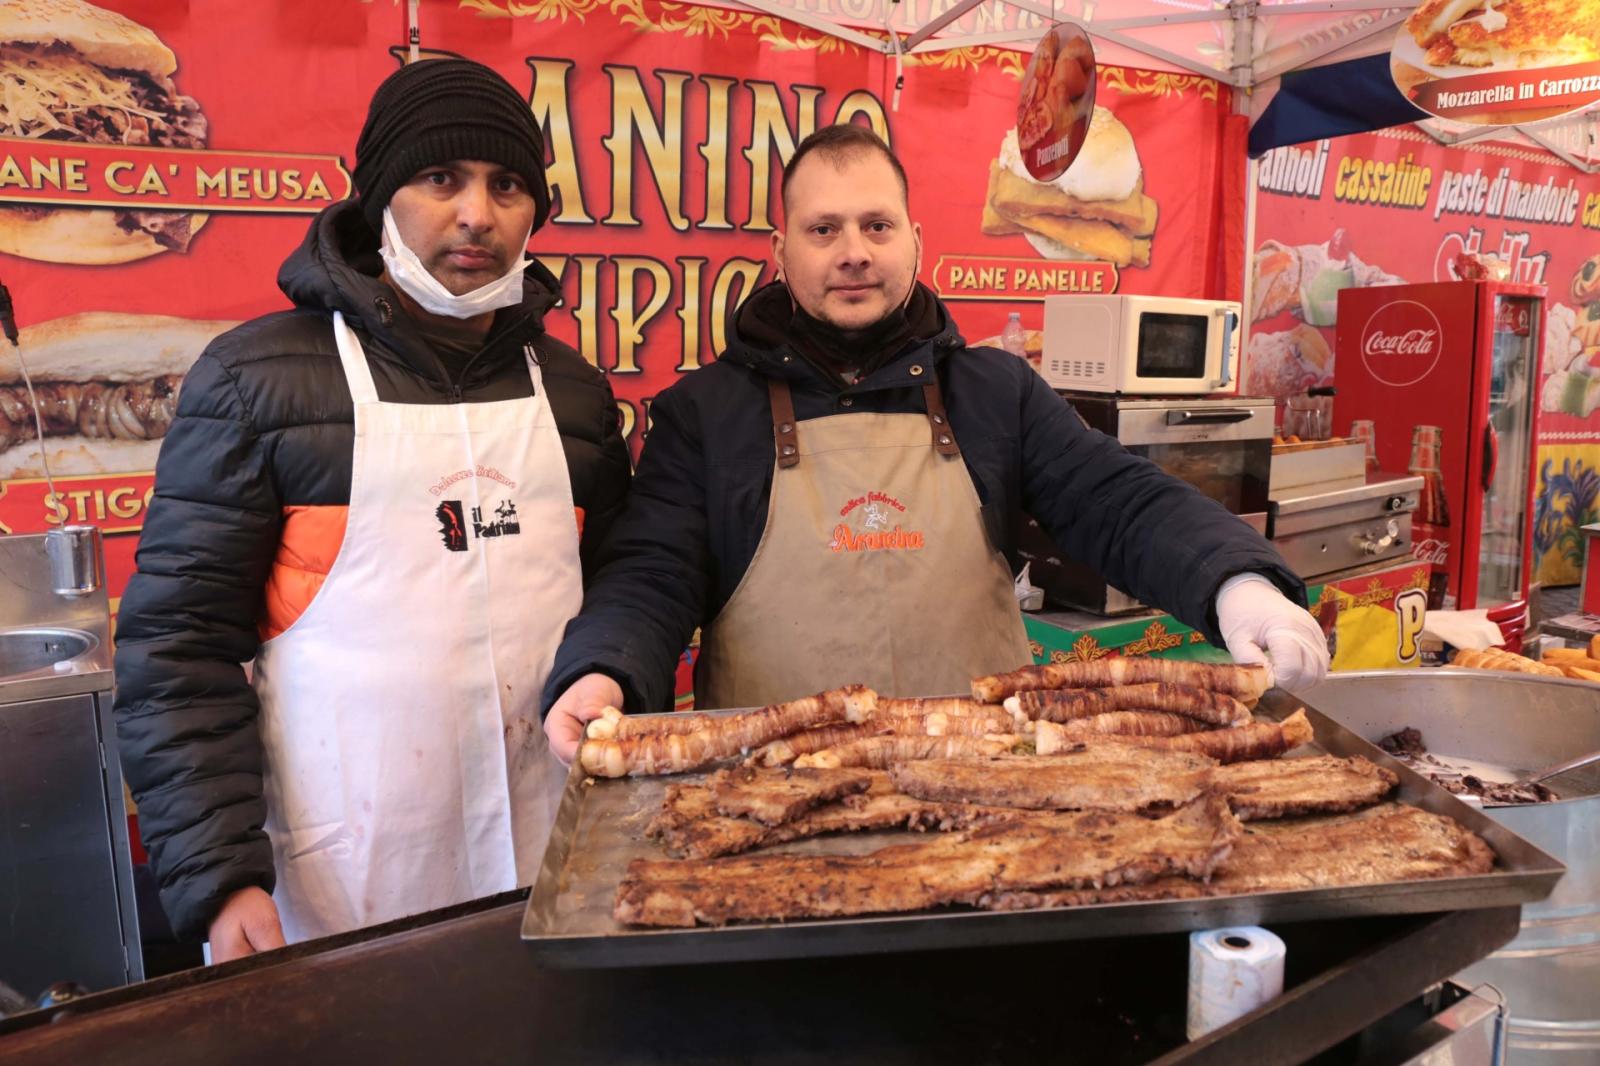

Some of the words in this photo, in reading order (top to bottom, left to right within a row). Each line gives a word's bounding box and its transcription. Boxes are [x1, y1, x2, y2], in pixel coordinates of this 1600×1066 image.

[1436, 86, 1515, 109] Mozzarella
[1518, 82, 1534, 99] in
[104, 161, 179, 195] CA'
[195, 166, 333, 201] MEUSA
[1334, 152, 1432, 210] cassatine
[1434, 168, 1489, 222] paste
[1486, 167, 1511, 217] di
[1504, 175, 1580, 226] mandorle
[950, 266, 1007, 290] PANE
[1013, 268, 1103, 293] PANELLE
